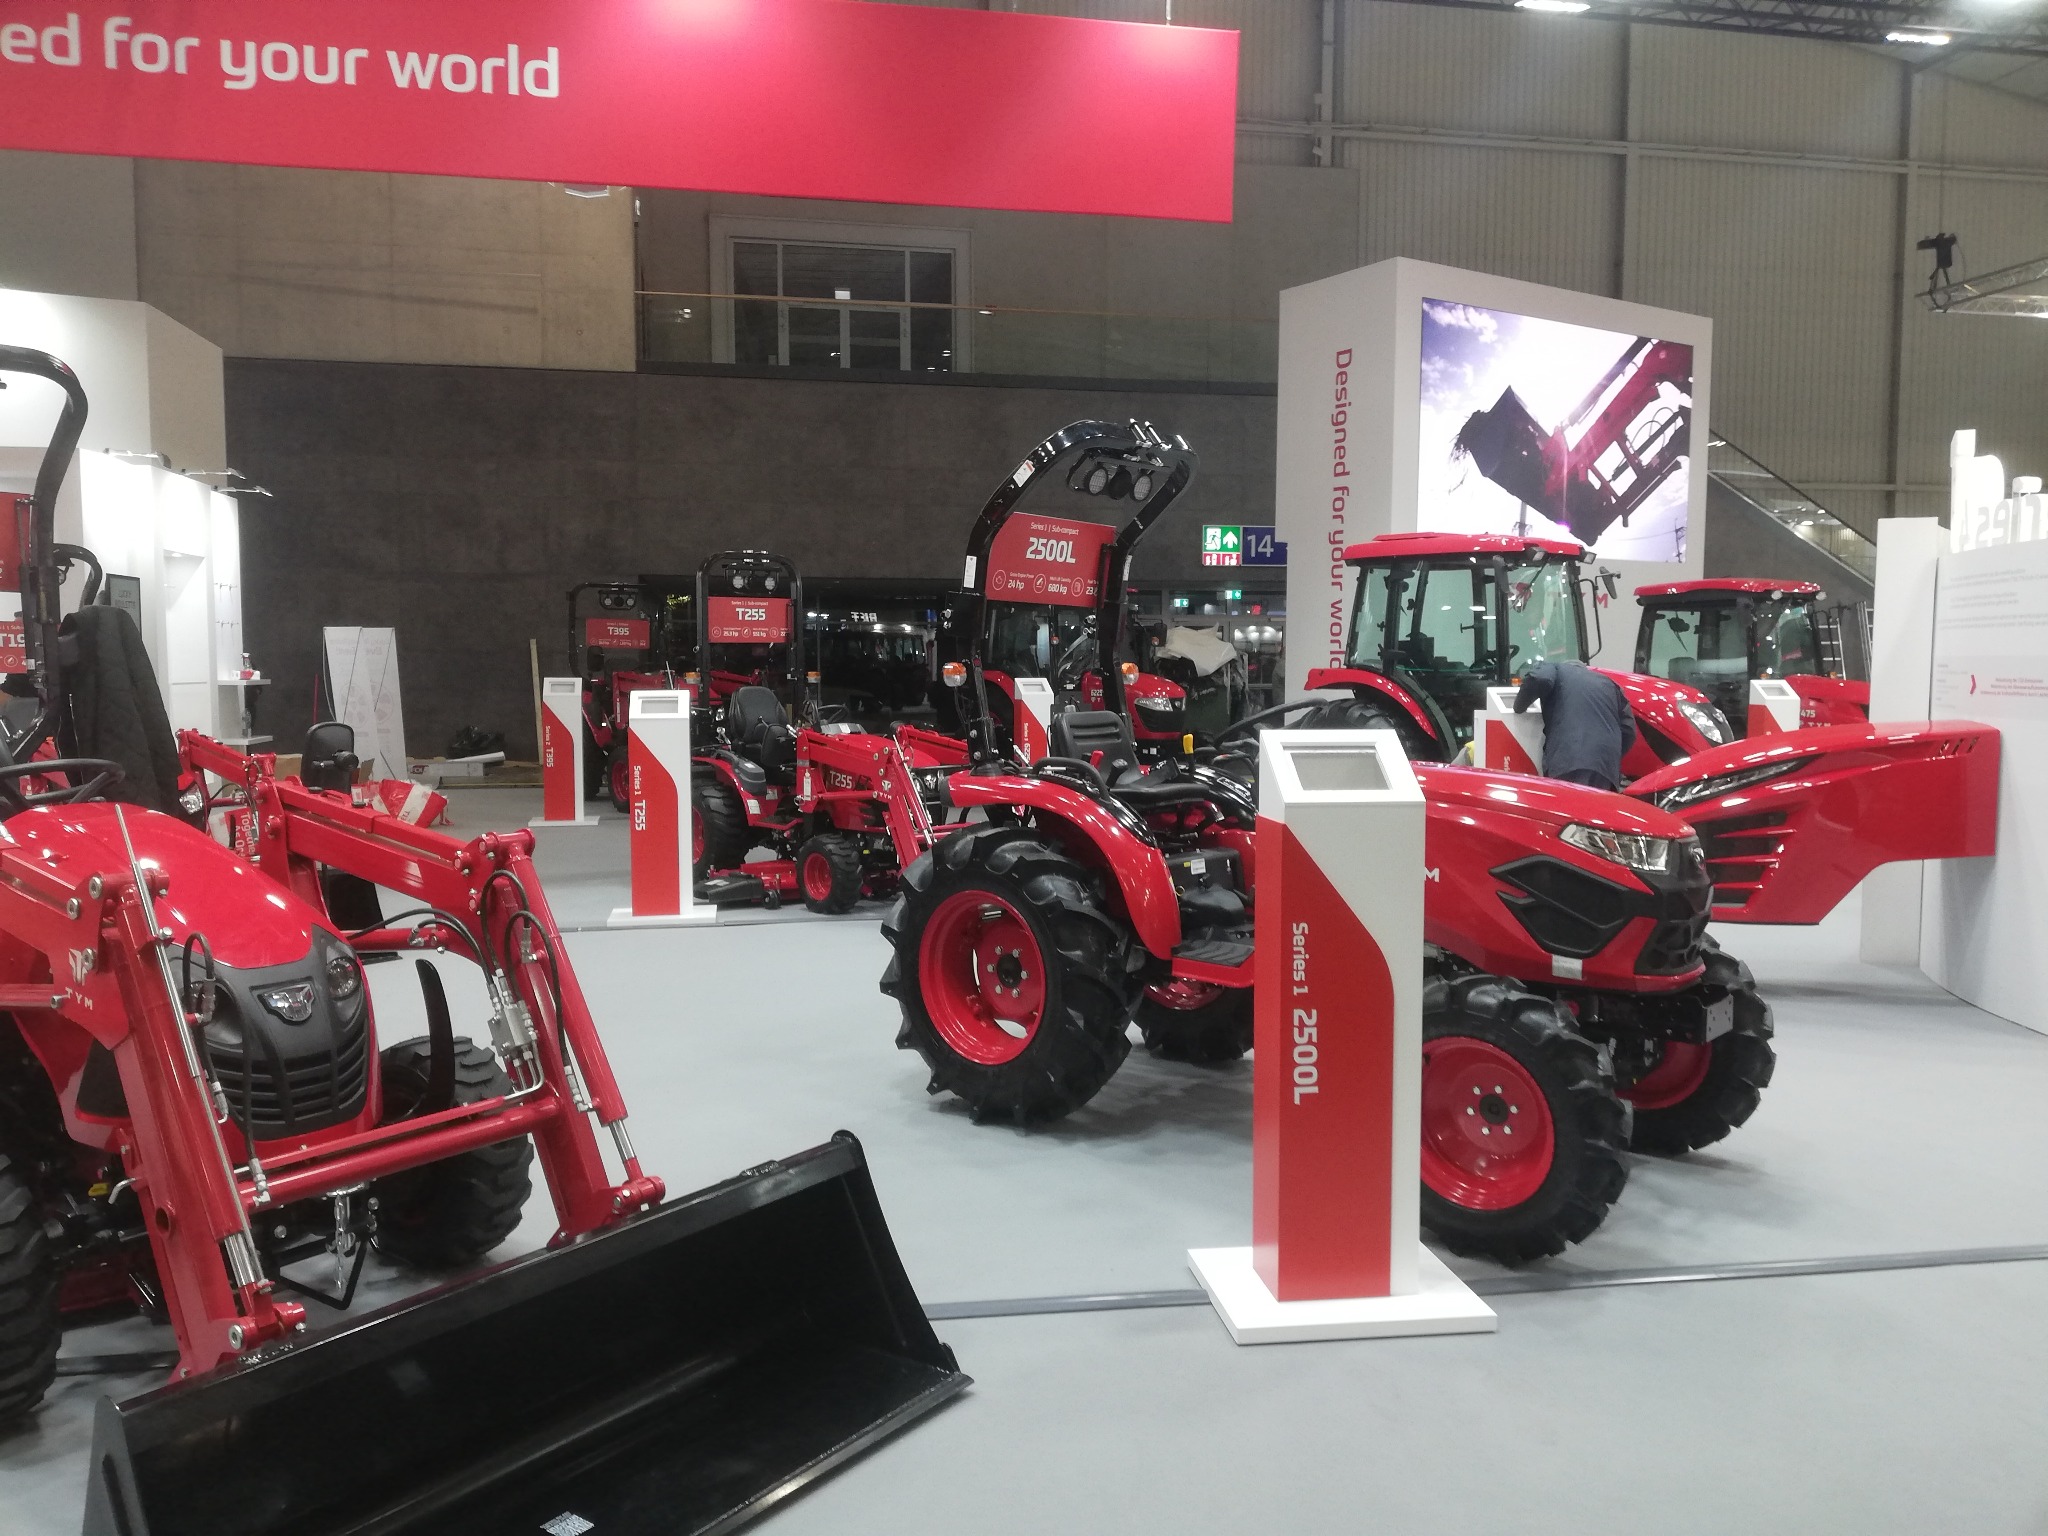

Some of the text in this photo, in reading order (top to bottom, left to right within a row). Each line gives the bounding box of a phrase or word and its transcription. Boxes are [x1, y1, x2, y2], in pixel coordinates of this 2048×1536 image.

[0, 14, 560, 99] ed for your world
[1331, 347, 1353, 478] Designed
[1332, 486, 1350, 524] for
[1030, 522, 1044, 532] Series
[1051, 525, 1079, 535] Sub-compact
[1026, 537, 1076, 564] 2500L
[1247, 534, 1274, 558] 14
[1328, 529, 1347, 592] your
[1008, 580, 1024, 590] 24 hp
[1048, 584, 1068, 595] 680 kg
[736, 608, 766, 621] T255
[607, 627, 630, 636] T395
[546, 747, 554, 768] T395
[634, 765, 642, 790] Series
[829, 770, 853, 789] T255
[634, 800, 646, 831] T255
[65, 986, 93, 1011] TYM
[1292, 922, 1320, 1106] Series 1 2500L
